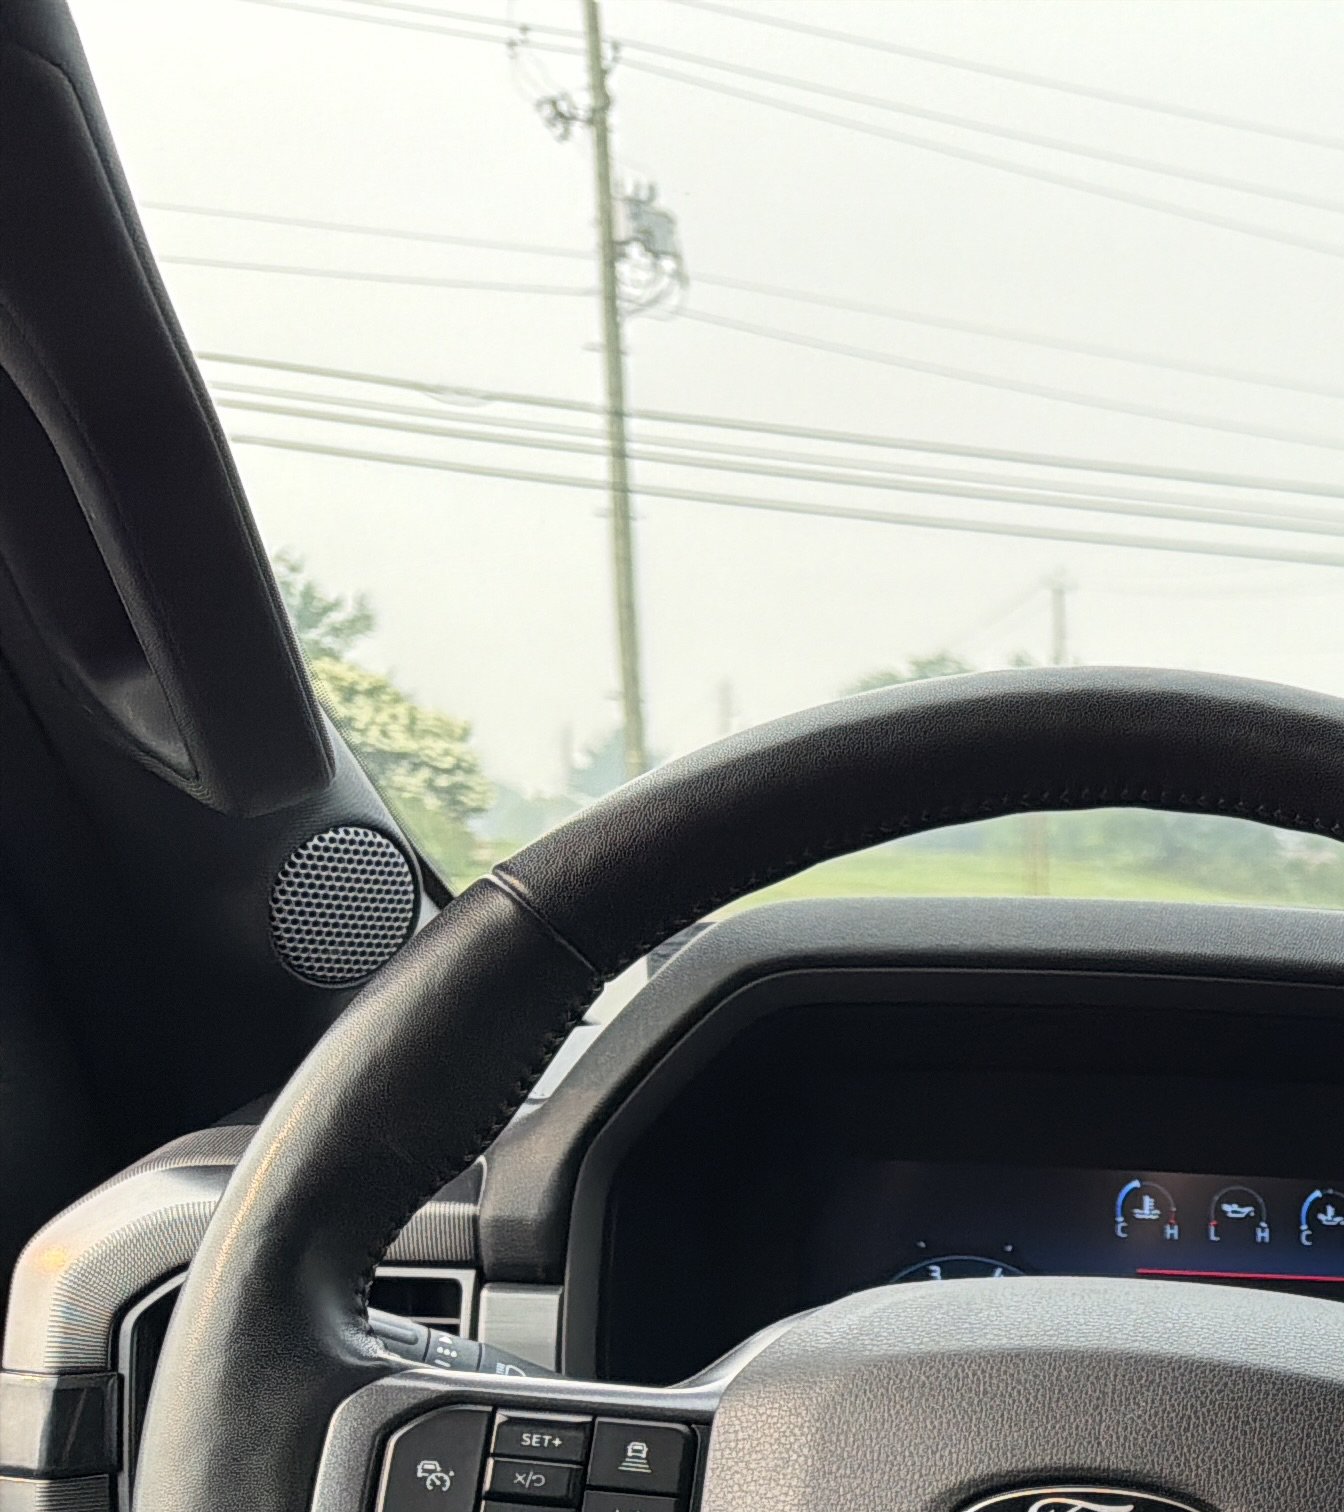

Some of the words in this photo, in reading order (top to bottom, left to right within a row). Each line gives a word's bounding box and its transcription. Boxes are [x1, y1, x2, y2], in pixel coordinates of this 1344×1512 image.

[1116, 1224, 1128, 1238] C
[1165, 1225, 1179, 1240] H
[1210, 1226, 1220, 1241] L
[1256, 1228, 1270, 1243] H
[1301, 1231, 1313, 1246] C
[520, 1433, 563, 1449] SET+
